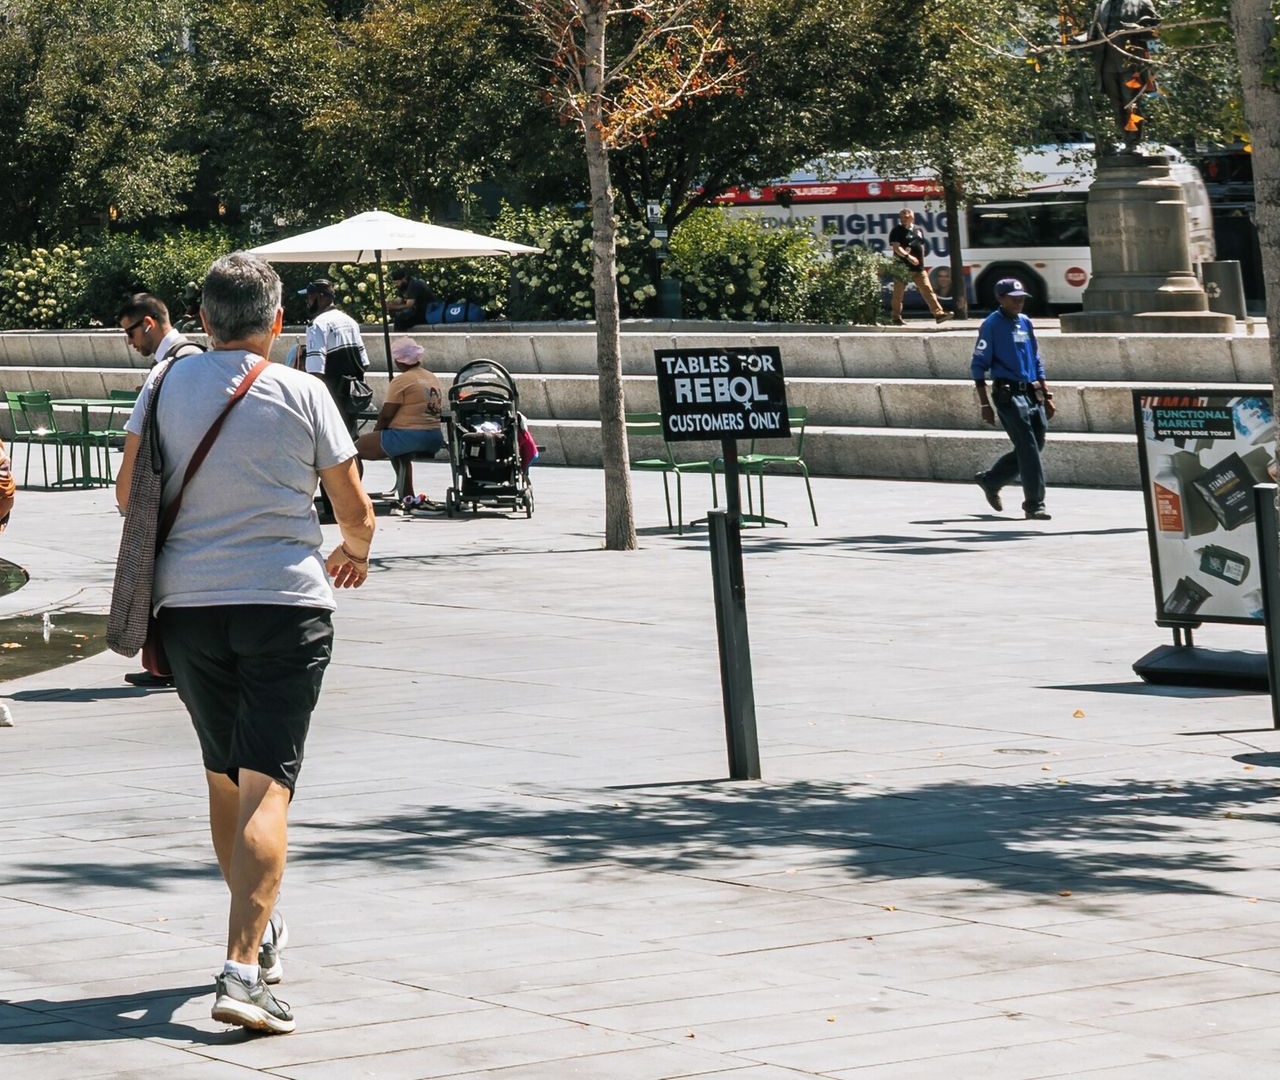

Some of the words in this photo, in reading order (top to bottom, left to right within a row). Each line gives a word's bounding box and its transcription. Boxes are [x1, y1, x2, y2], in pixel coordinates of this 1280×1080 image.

[822, 212, 949, 235] FIGHTNG
[661, 355, 730, 374] TABLES
[737, 354, 775, 373] FOR
[674, 376, 768, 404] REBOL
[669, 413, 744, 432] CUSTOMERS
[748, 411, 781, 430] ONLY
[1156, 410, 1229, 419] FUNCTIONAL
[1158, 419, 1205, 428] MARKET
